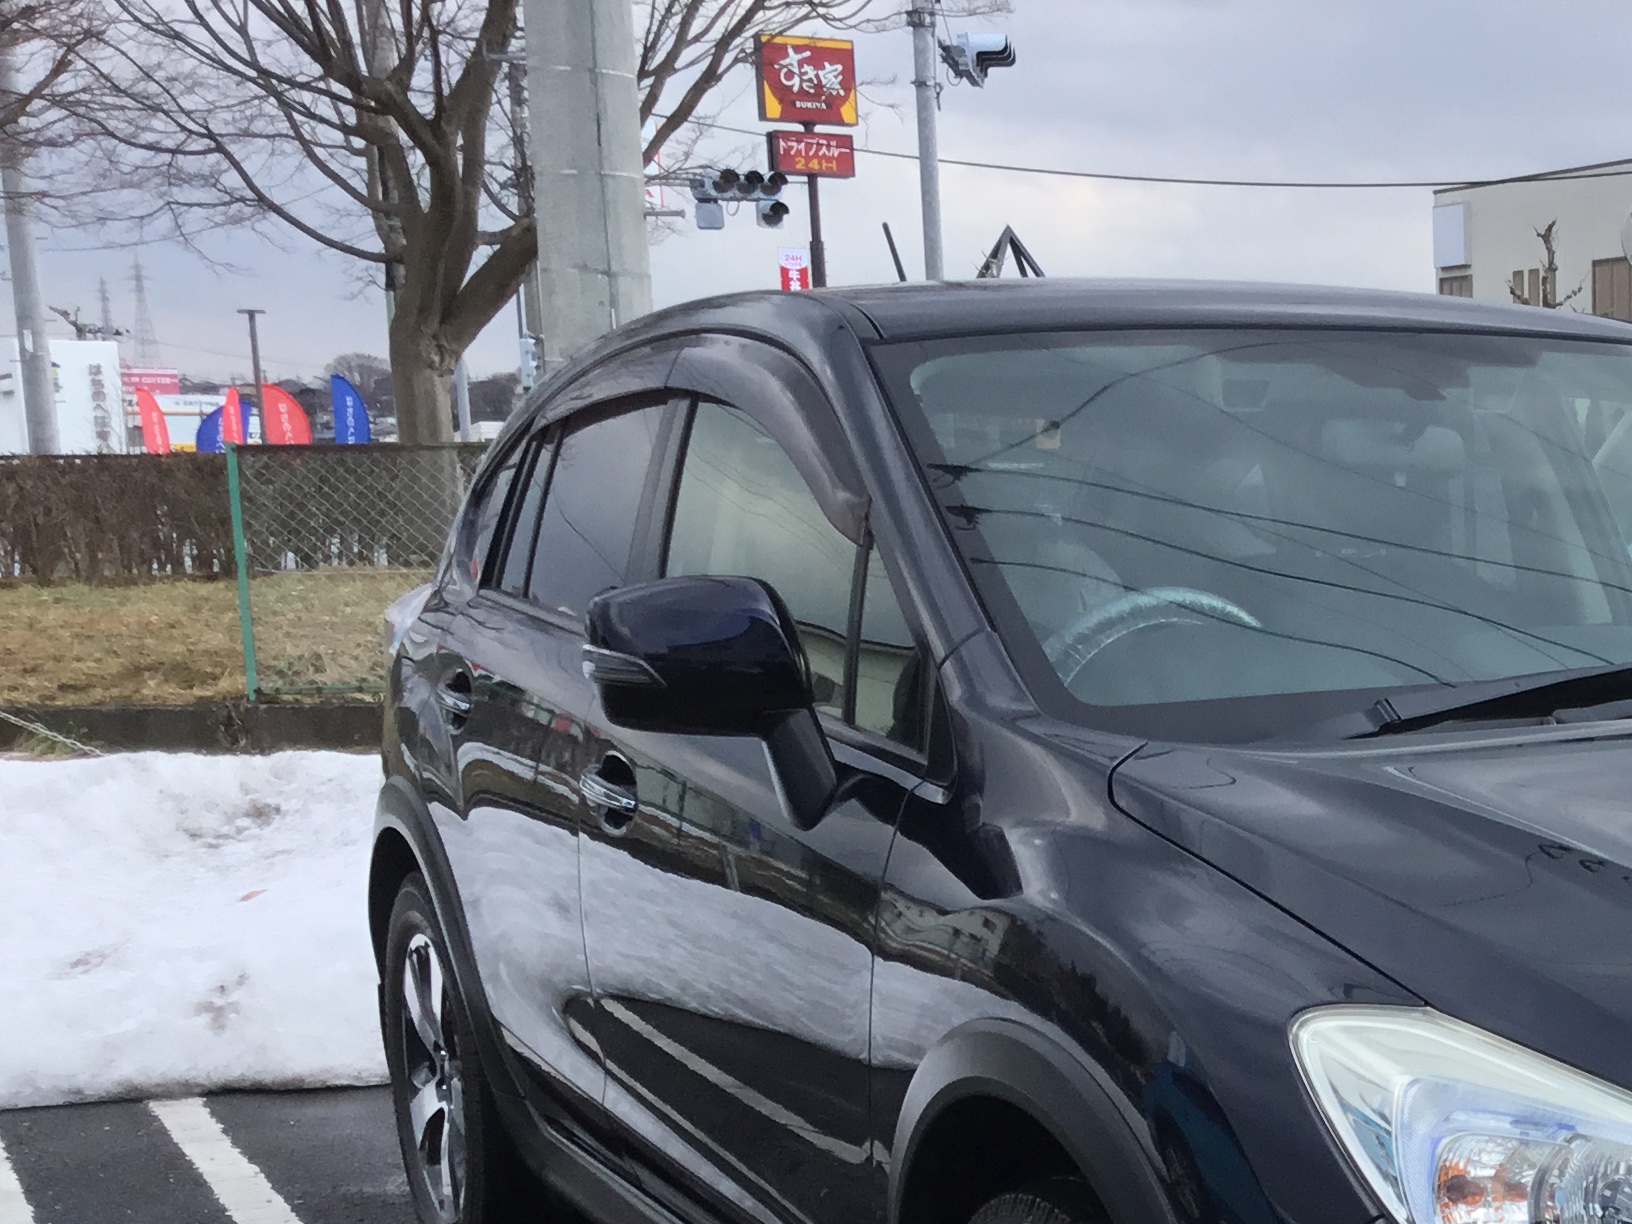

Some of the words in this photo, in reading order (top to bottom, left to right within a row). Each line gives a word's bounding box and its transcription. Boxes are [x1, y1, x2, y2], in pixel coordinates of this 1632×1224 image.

[774, 45, 846, 99] すき家
[794, 156, 838, 172] 24H
